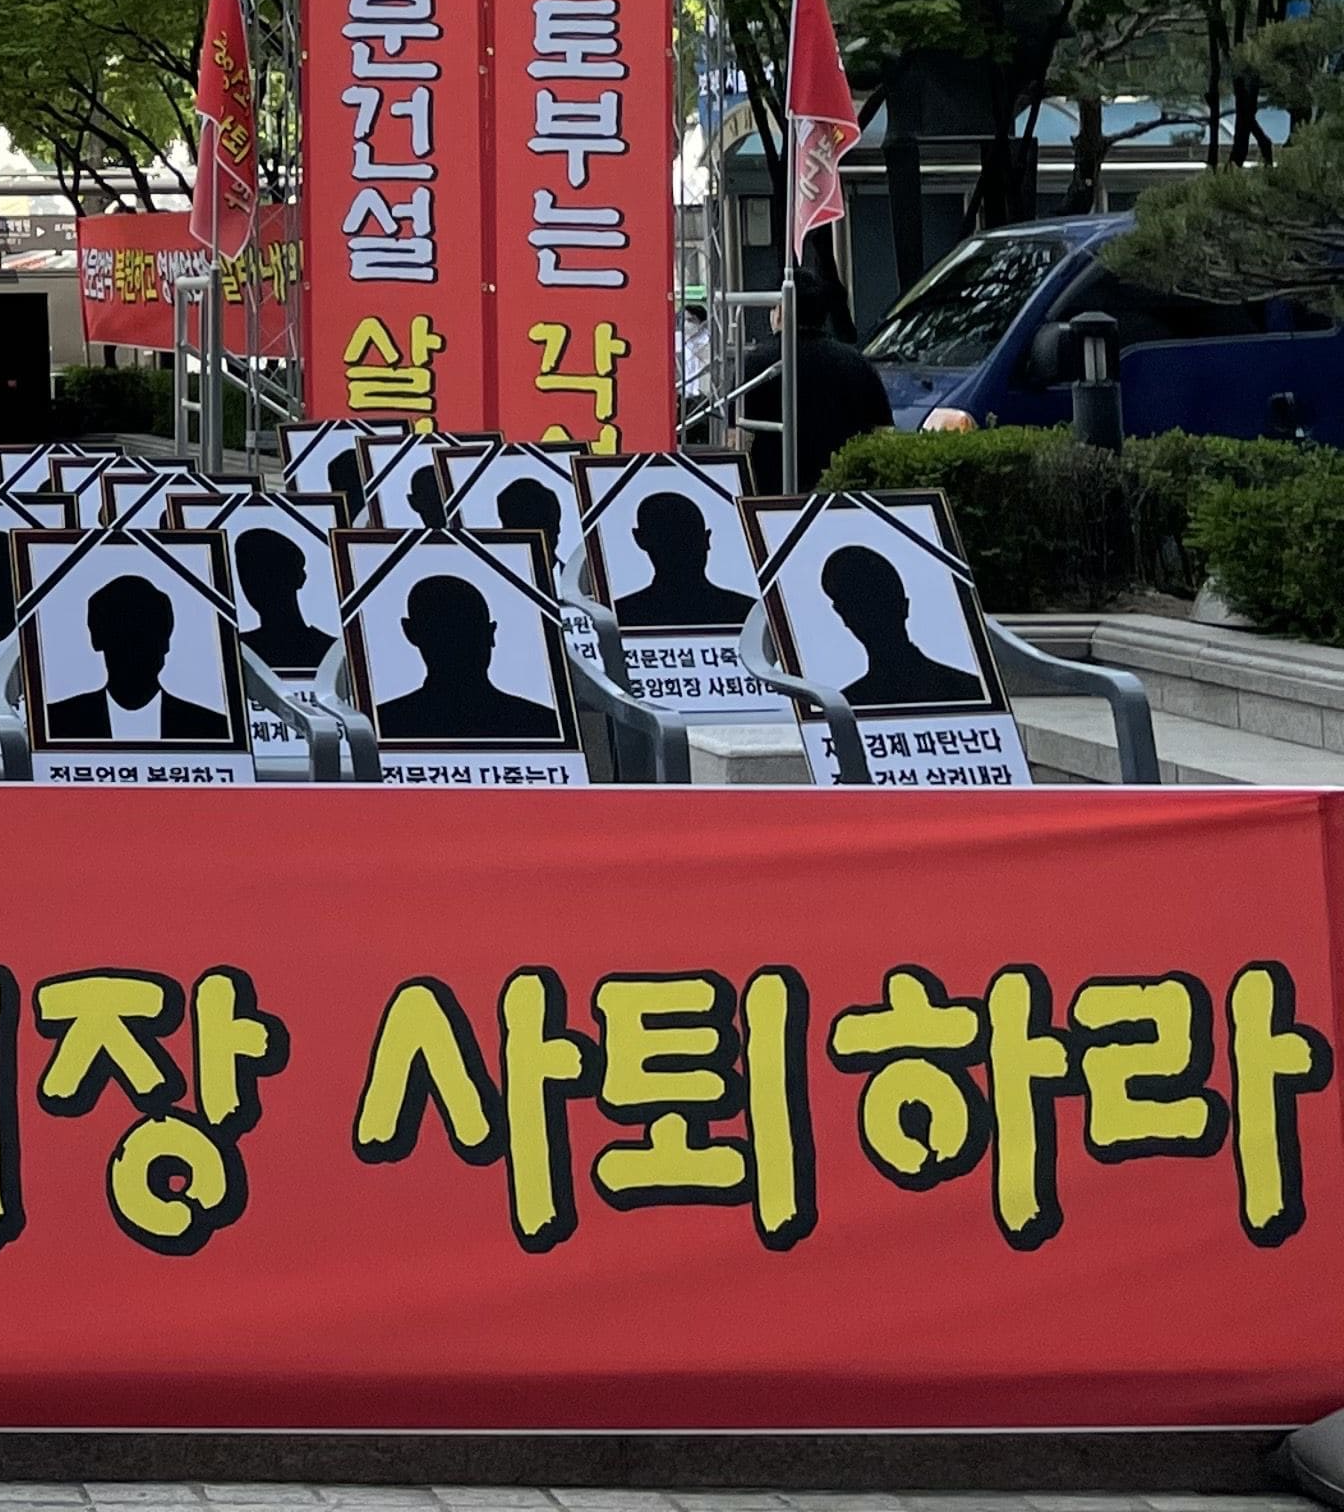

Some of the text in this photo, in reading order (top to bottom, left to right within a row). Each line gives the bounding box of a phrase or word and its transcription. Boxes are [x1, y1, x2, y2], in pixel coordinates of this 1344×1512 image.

[343, 314, 446, 434] 살
[625, 647, 696, 670] 전문건설
[914, 727, 1002, 756] 파탄난다
[350, 960, 1330, 1251] 사퇴하라
